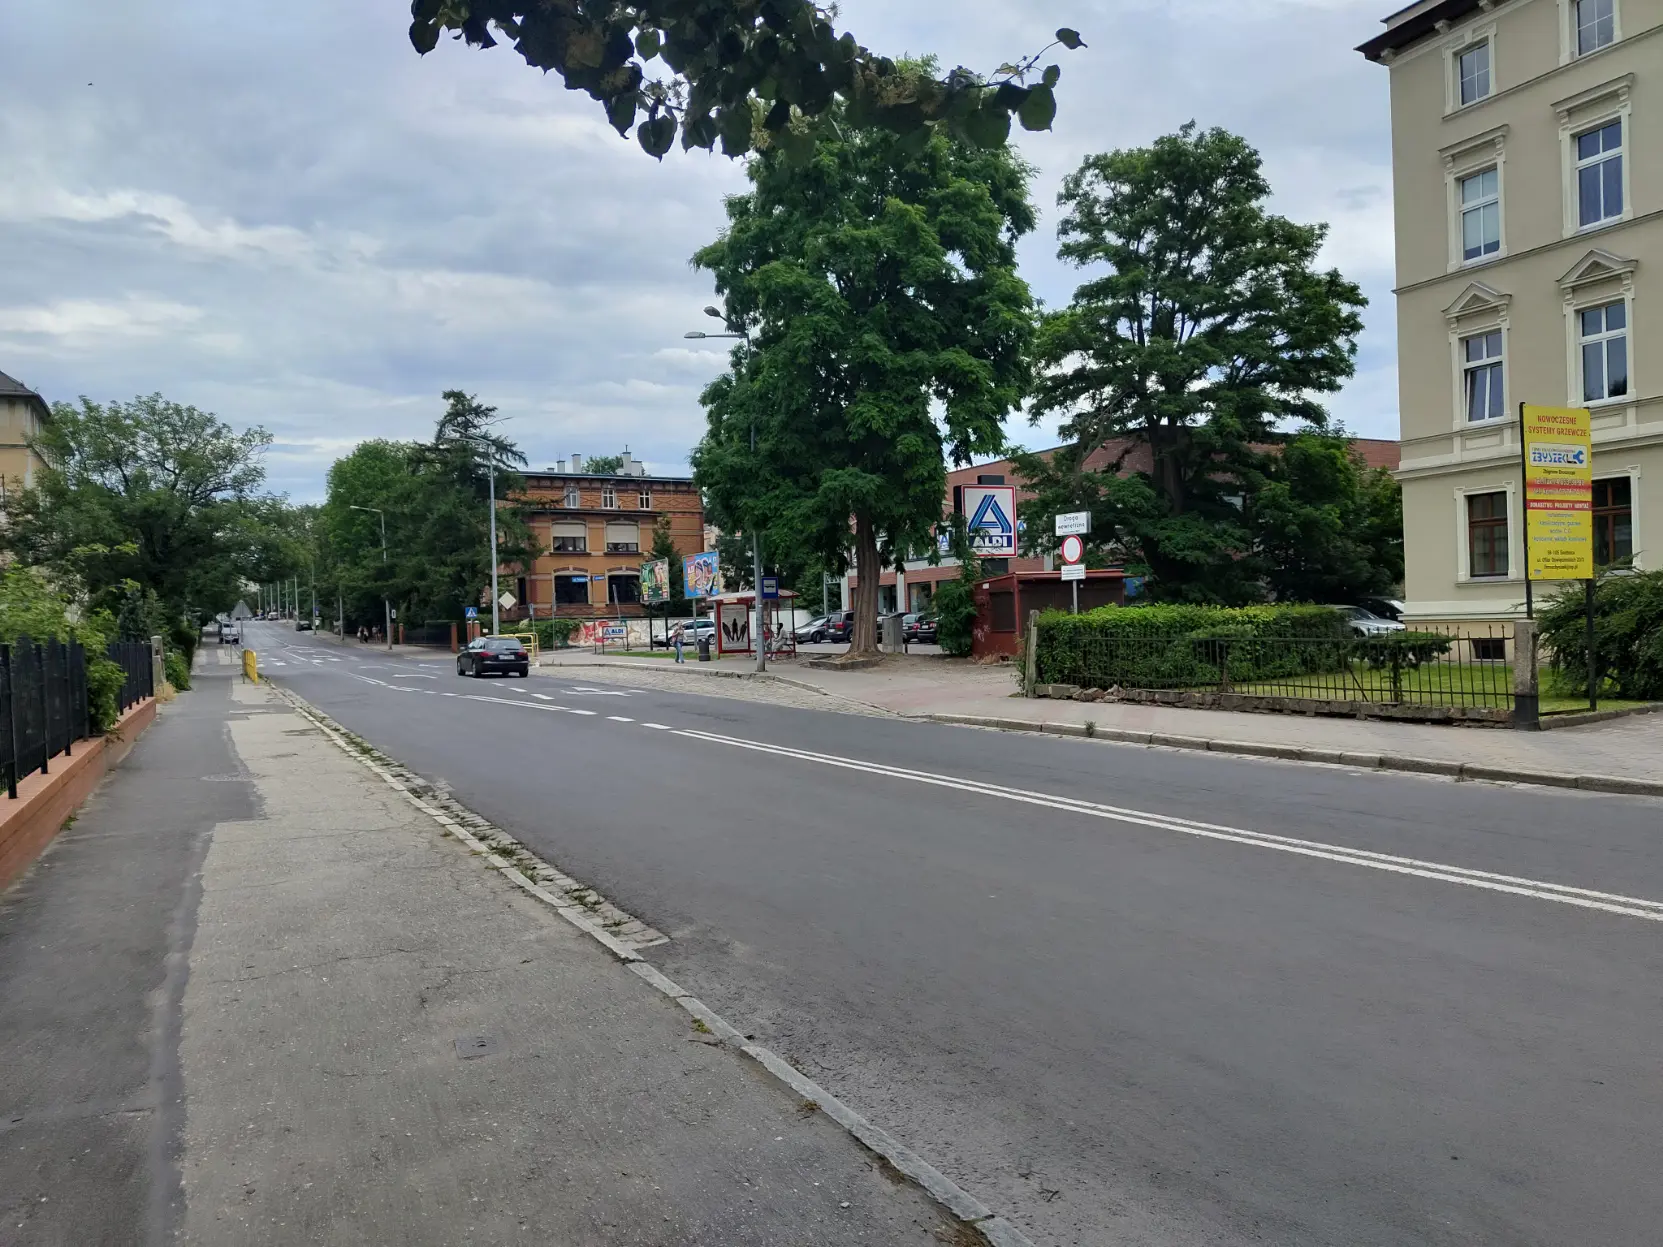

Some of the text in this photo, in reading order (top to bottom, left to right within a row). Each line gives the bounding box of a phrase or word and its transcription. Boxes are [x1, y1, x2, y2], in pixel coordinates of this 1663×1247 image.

[1537, 415, 1577, 425] NOWOCZESNE
[1528, 426, 1555, 435] SYSTEMY
[972, 536, 1008, 547] ALDI
